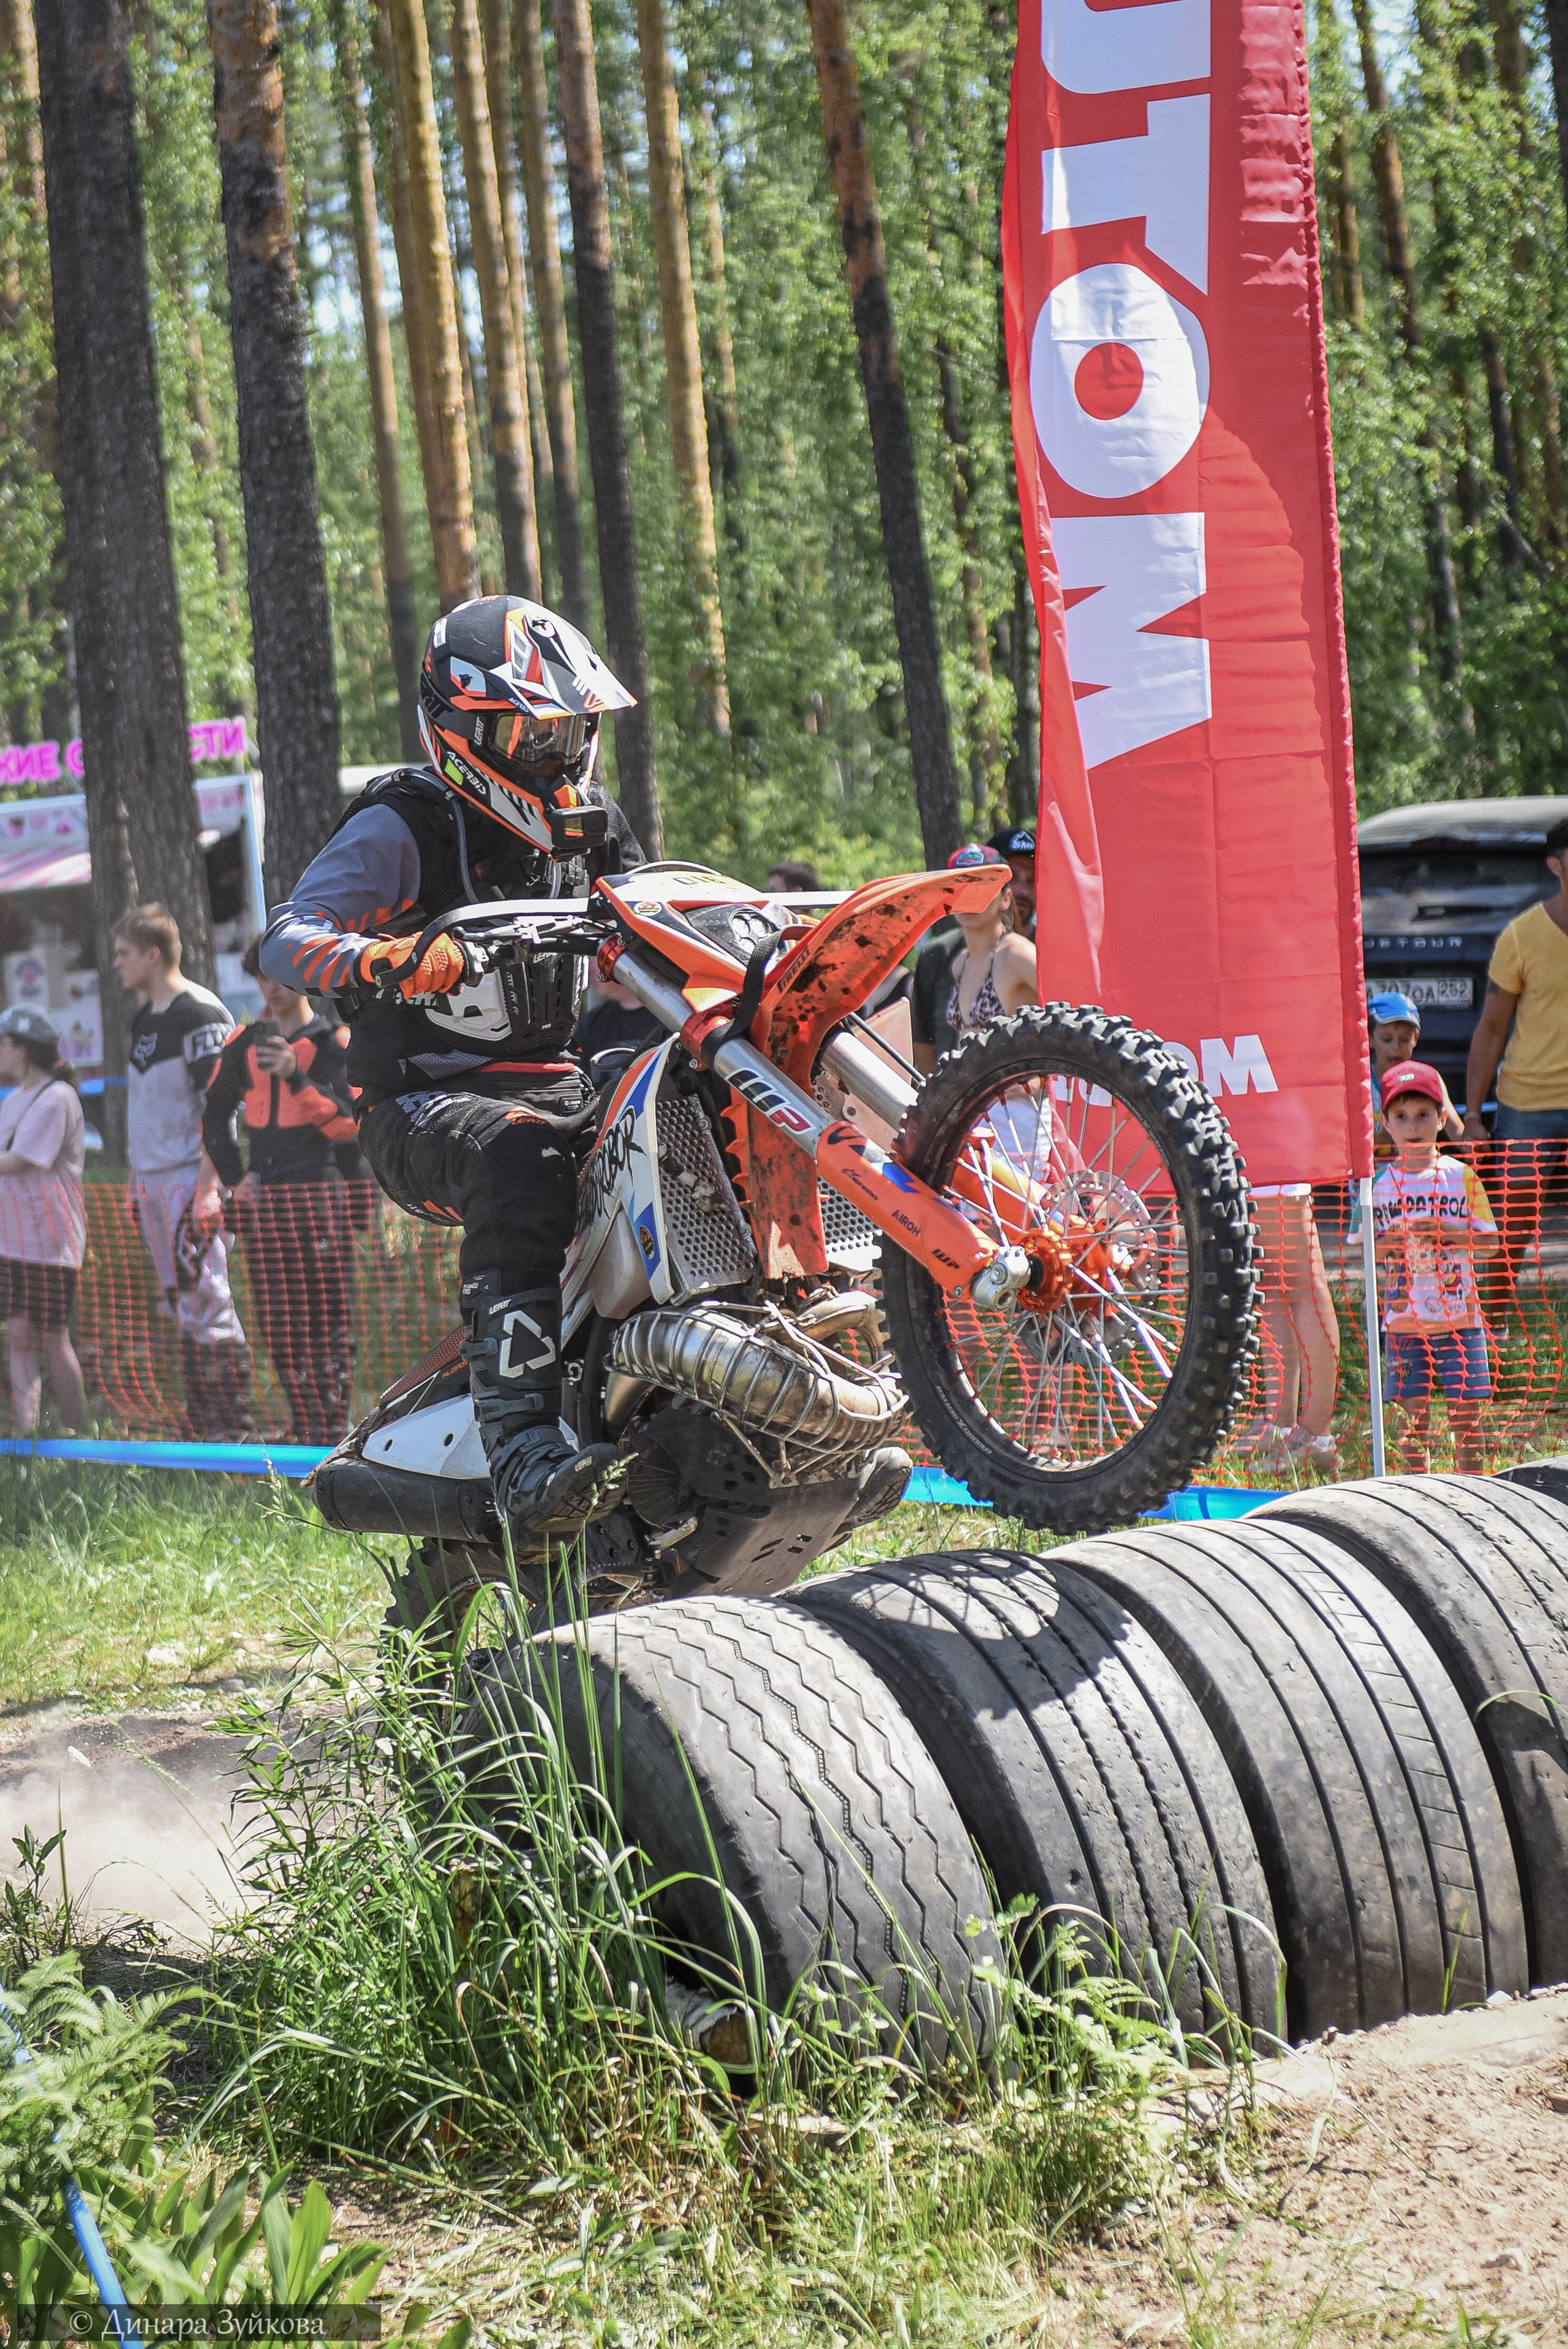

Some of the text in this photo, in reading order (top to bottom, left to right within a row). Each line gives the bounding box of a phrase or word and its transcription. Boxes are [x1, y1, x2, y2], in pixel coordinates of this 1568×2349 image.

[473, 715, 484, 746] LEATT
[891, 1208, 921, 1238] AIROH
[489, 1299, 512, 1315] LEATT
